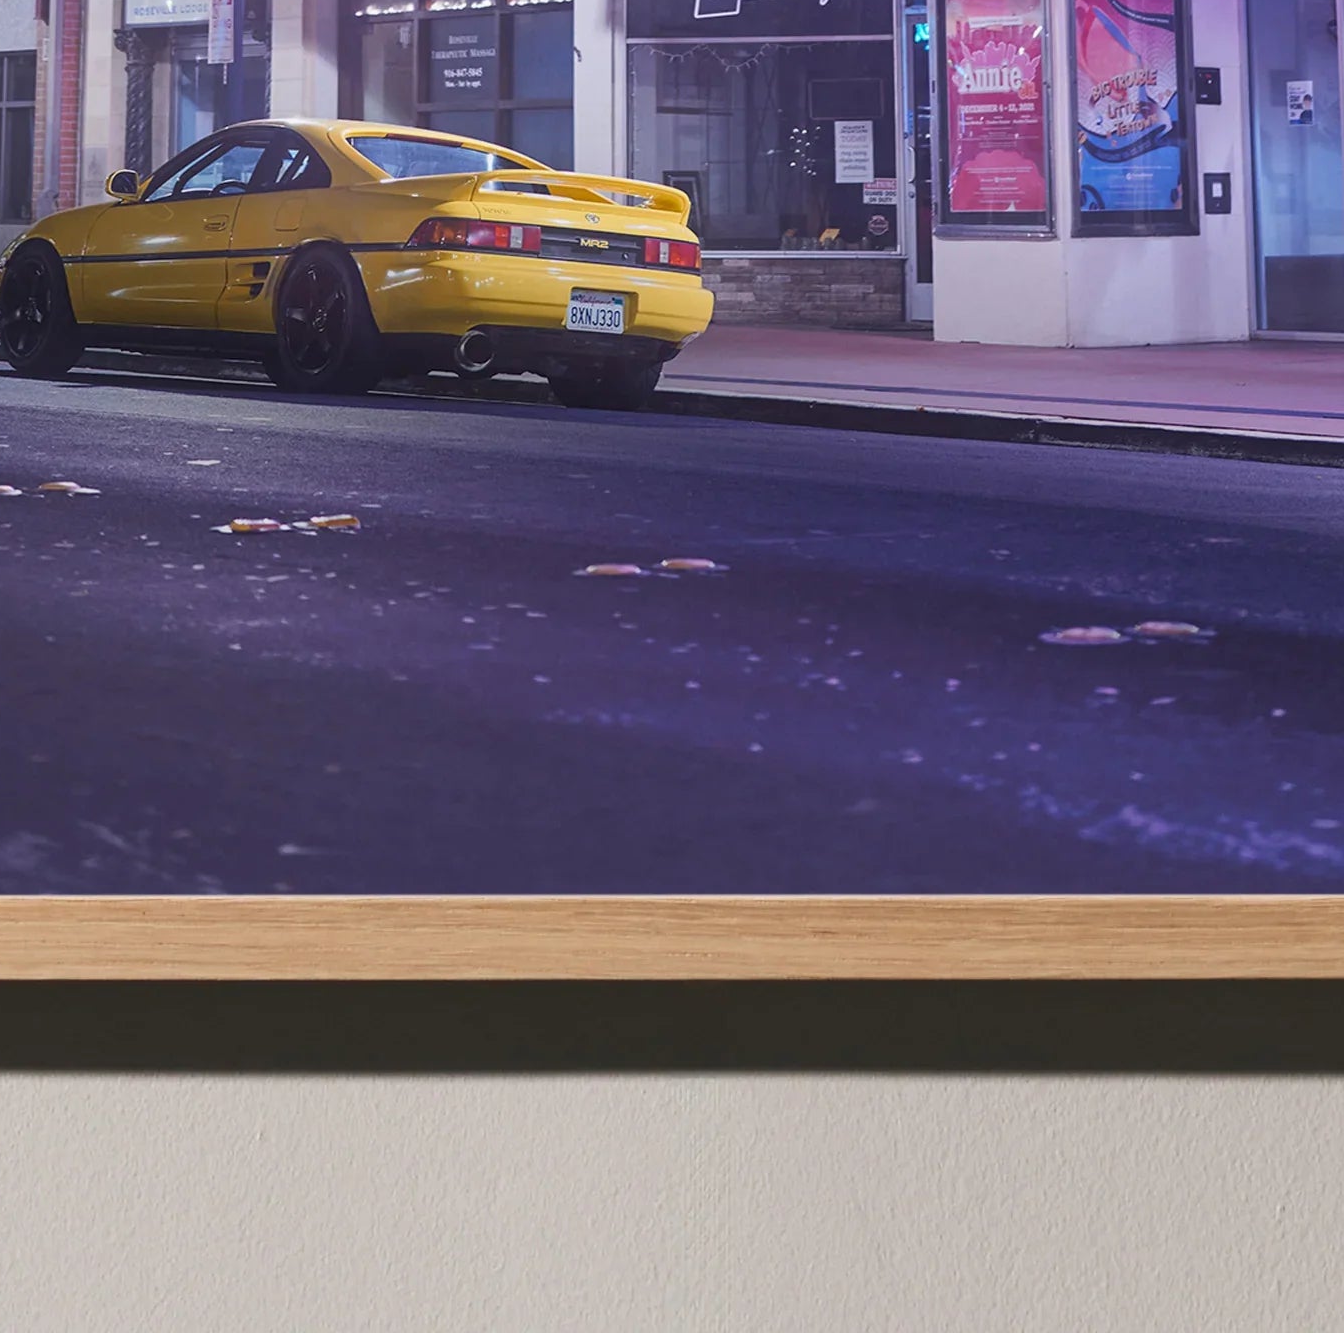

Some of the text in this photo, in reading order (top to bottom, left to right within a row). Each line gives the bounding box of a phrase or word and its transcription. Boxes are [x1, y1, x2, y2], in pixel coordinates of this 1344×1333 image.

[133, 3, 209, 17] ROSEVILLE LODGE
[958, 60, 1022, 94] Annie
[1089, 69, 1159, 105] BIG TROUBLE
[1107, 102, 1141, 119] LITTLE
[580, 237, 609, 249] MR2
[571, 306, 621, 328] 8XNJ330
